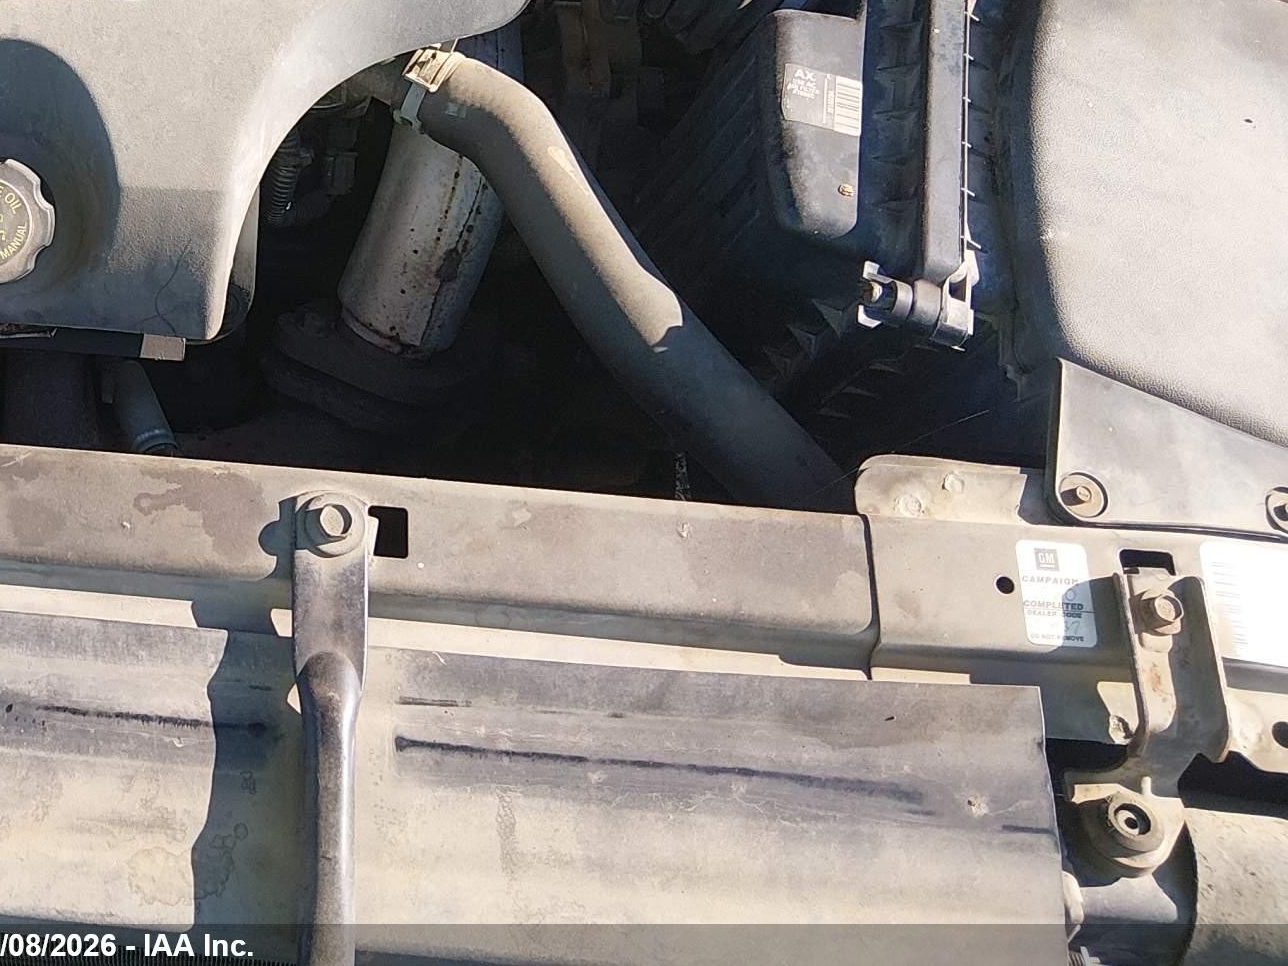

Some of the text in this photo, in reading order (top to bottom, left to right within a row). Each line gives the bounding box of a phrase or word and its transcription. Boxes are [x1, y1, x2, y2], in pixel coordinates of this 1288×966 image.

[794, 69, 814, 81] AX
[5, 193, 22, 214] OIL
[0, 224, 27, 259] MANUAL
[1039, 553, 1055, 563] GM
[1024, 600, 1084, 610] COMPLETED
